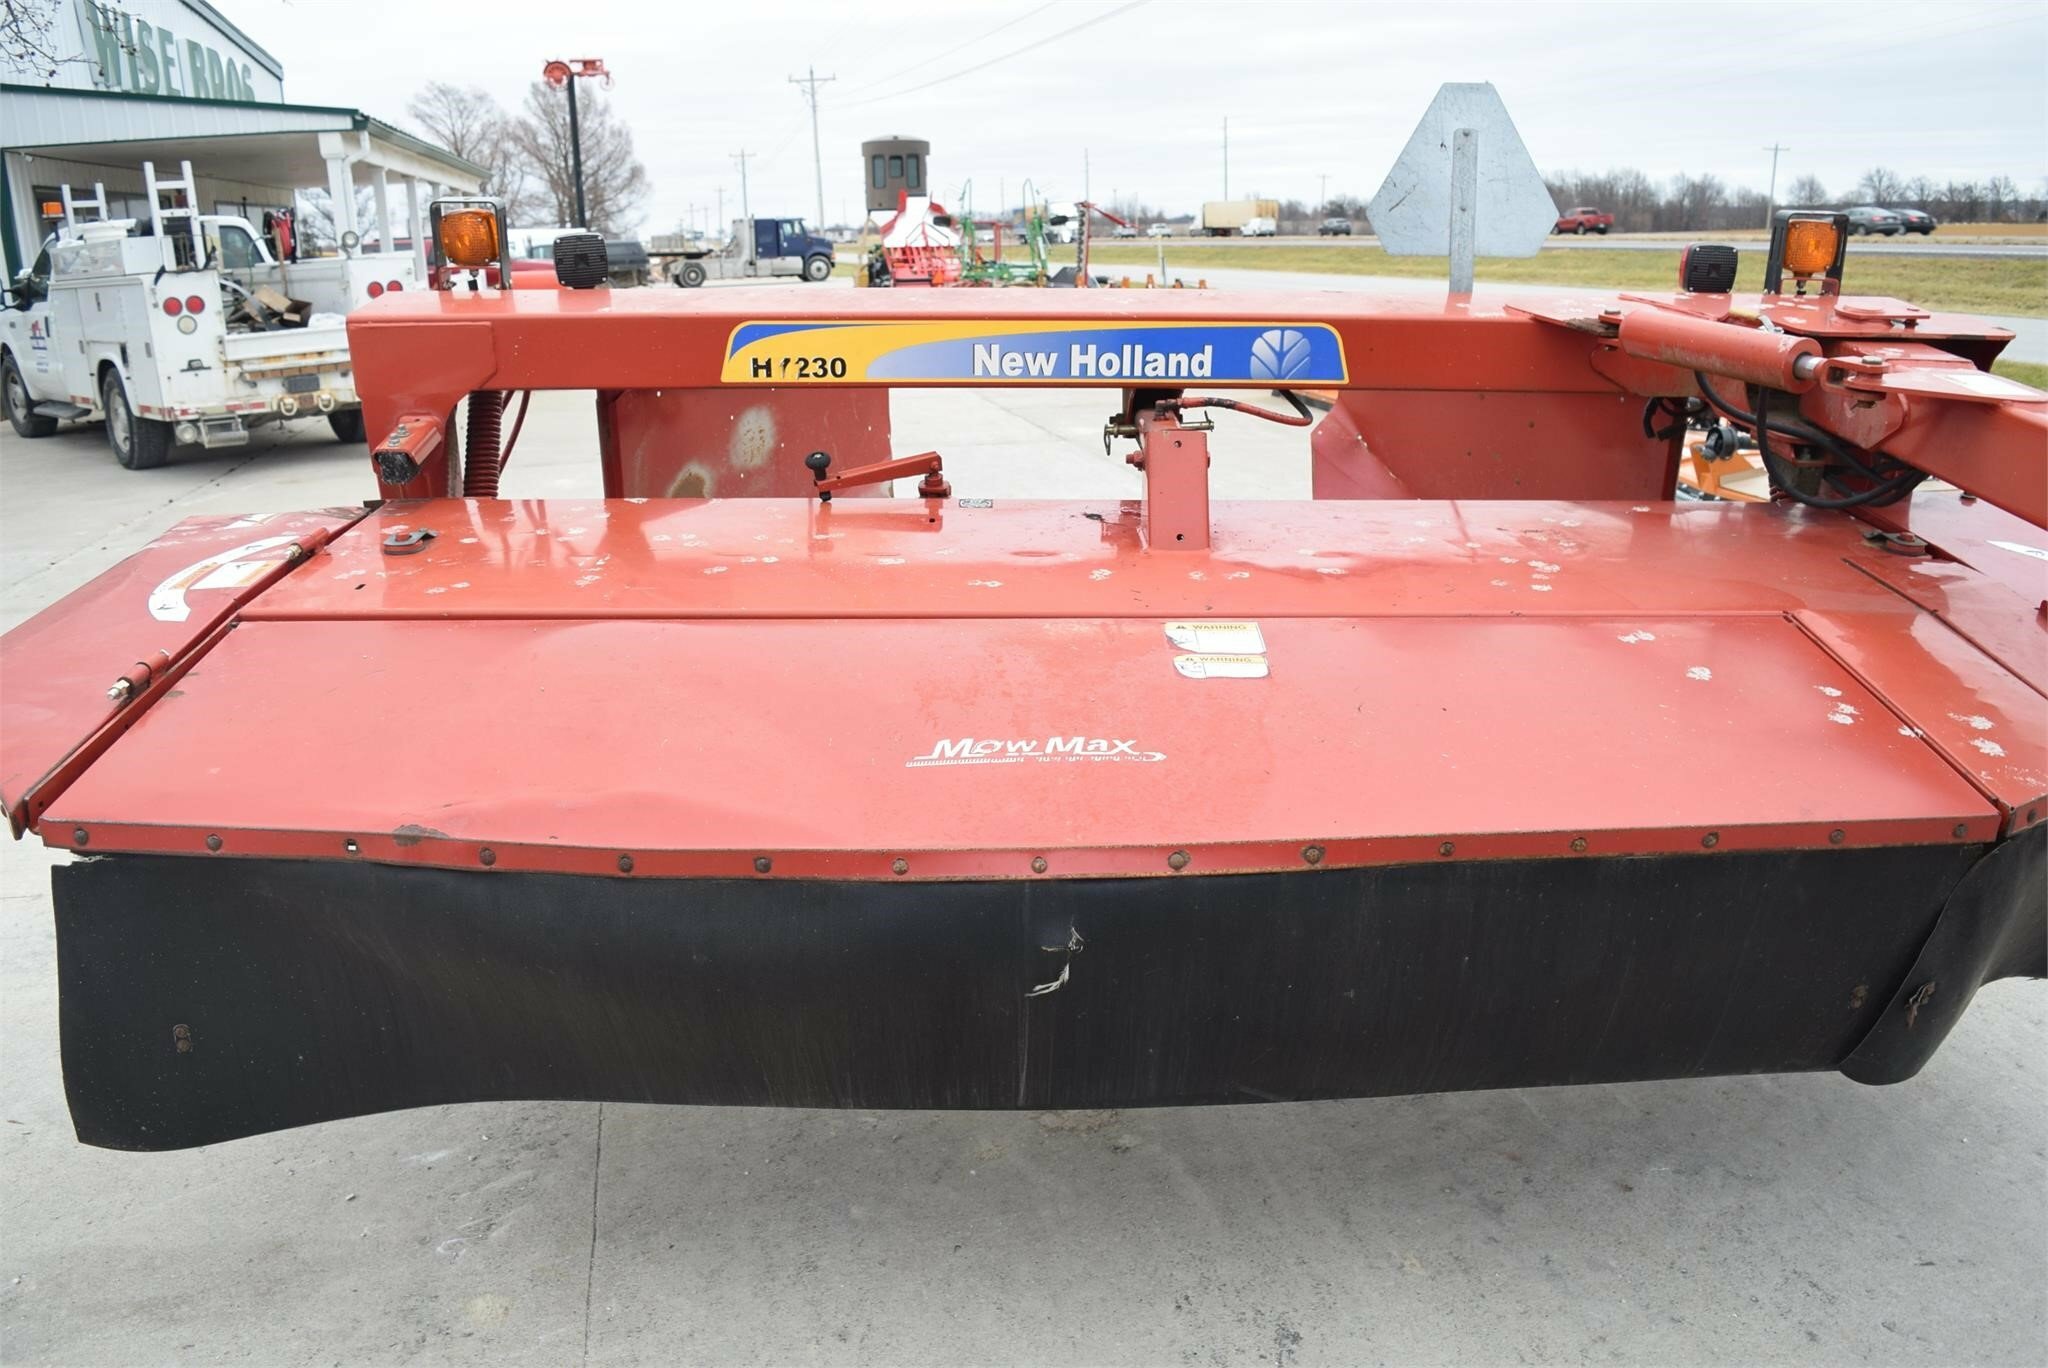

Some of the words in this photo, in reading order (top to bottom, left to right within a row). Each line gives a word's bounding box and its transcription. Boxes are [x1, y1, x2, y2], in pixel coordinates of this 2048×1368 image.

[84, 0, 181, 97] WISE
[973, 343, 1058, 377] New
[1070, 343, 1213, 377] Holland
